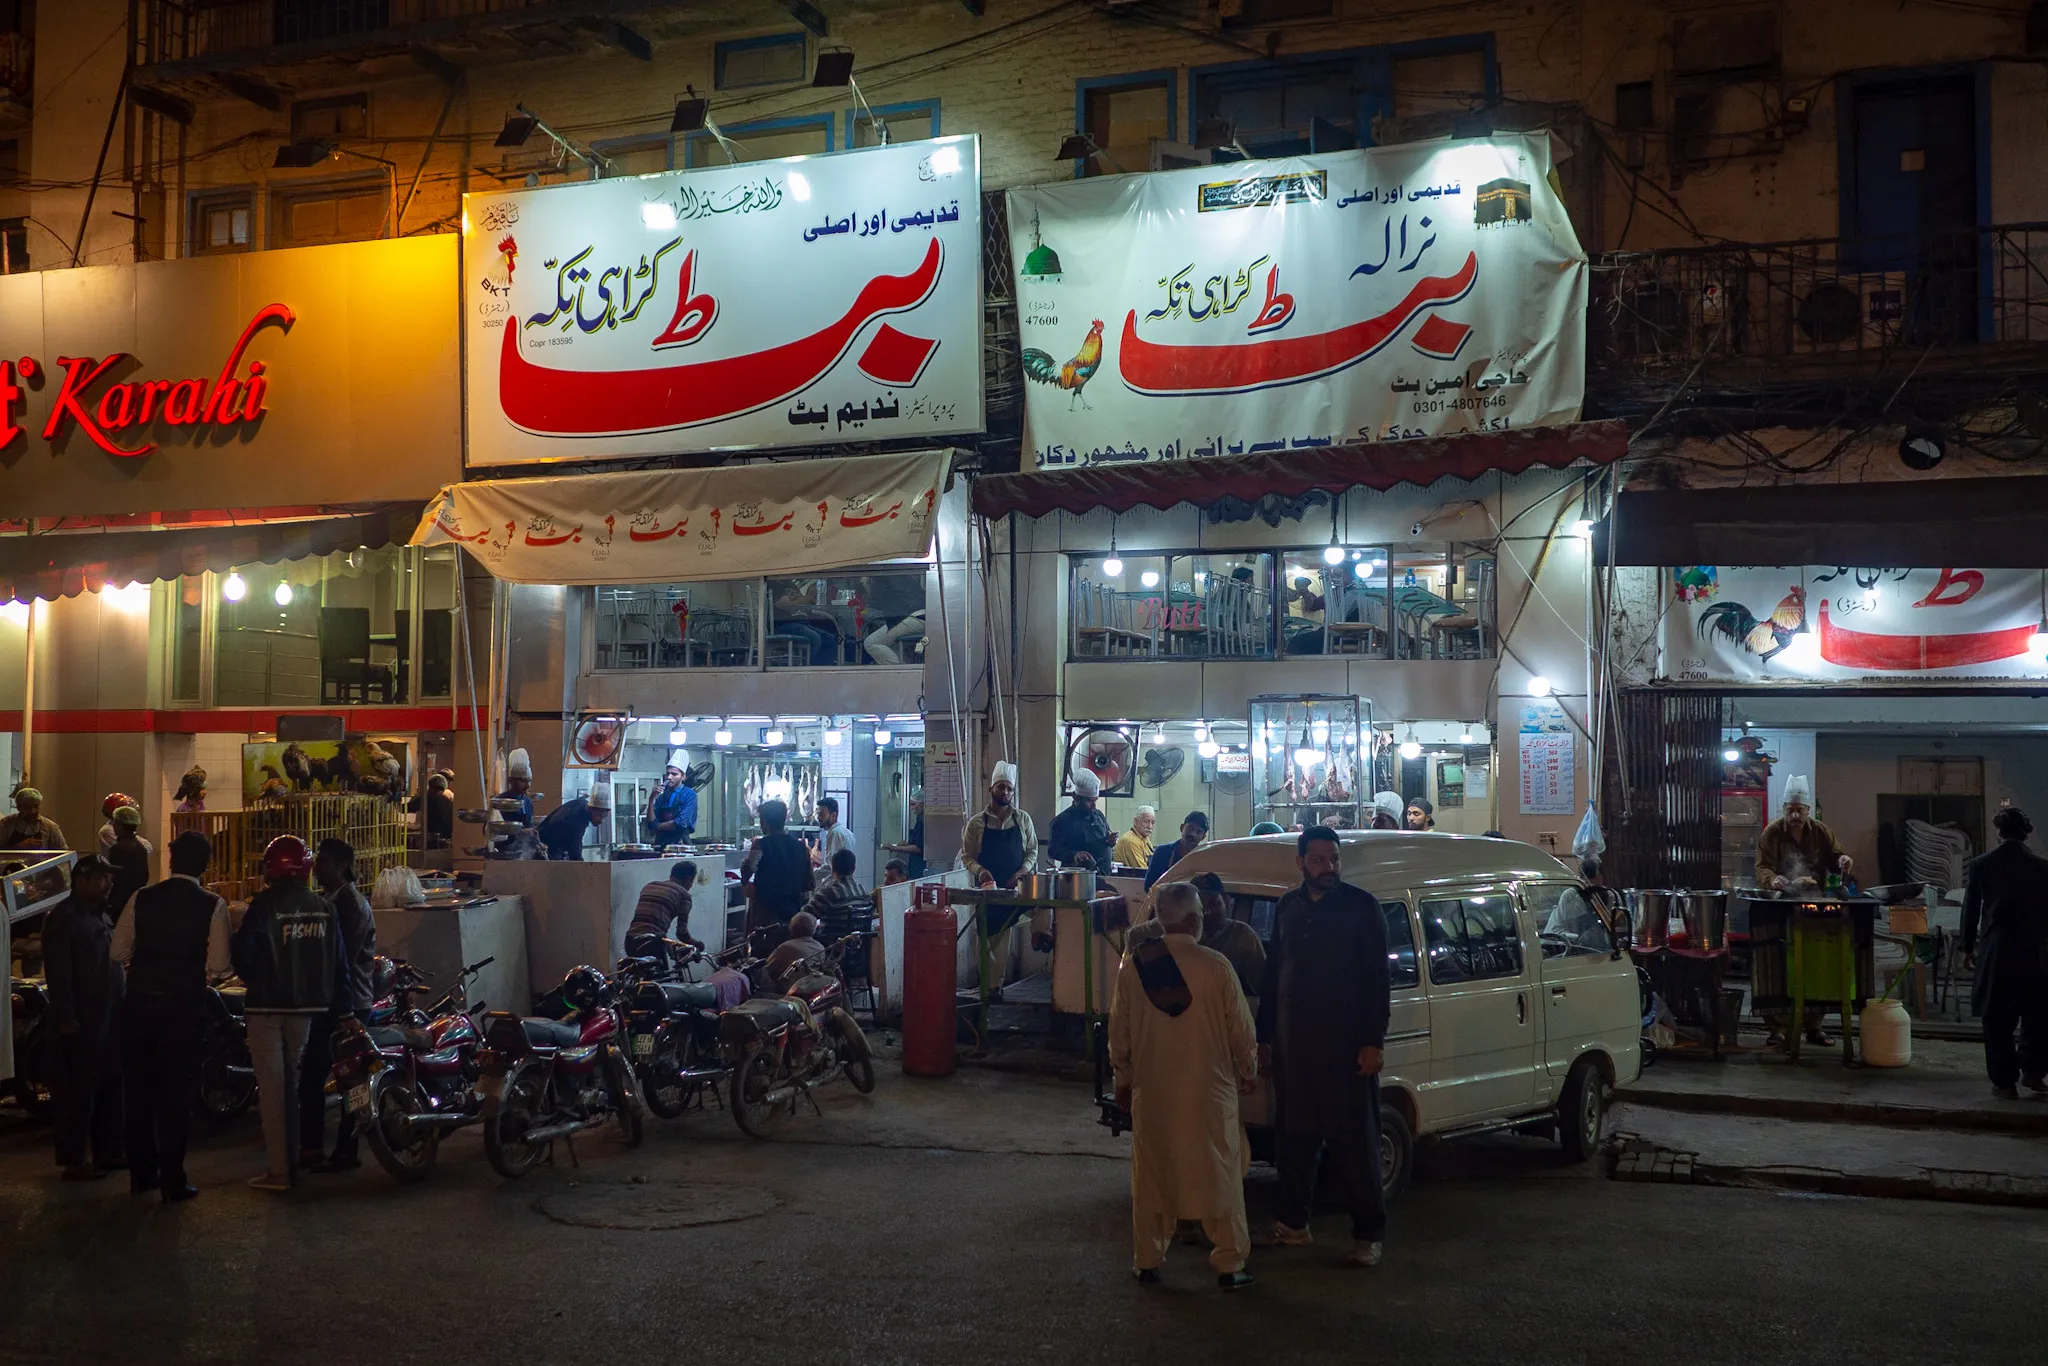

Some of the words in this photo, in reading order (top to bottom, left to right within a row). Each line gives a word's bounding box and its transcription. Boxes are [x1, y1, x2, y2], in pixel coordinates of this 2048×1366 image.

[1337, 187, 1379, 208] اصلی
[1382, 184, 1403, 204] اور
[862, 208, 887, 237] اور
[891, 199, 960, 234] قدیمی
[803, 214, 857, 243] اصلی
[480, 278, 511, 298] BKT
[482, 319, 504, 328] 30250
[1025, 315, 1059, 326] 47600
[529, 339, 546, 349] Copr
[548, 336, 573, 347] 183595
[42, 303, 296, 457] Karahi
[1390, 375, 1421, 396] بٹ
[1425, 368, 1471, 396] امین
[836, 390, 899, 433] ندیم
[1413, 395, 1506, 413] 0301-4807646
[788, 399, 829, 431] بٹ
[1137, 597, 1207, 630] Butt
[1679, 671, 1708, 680] 47600
